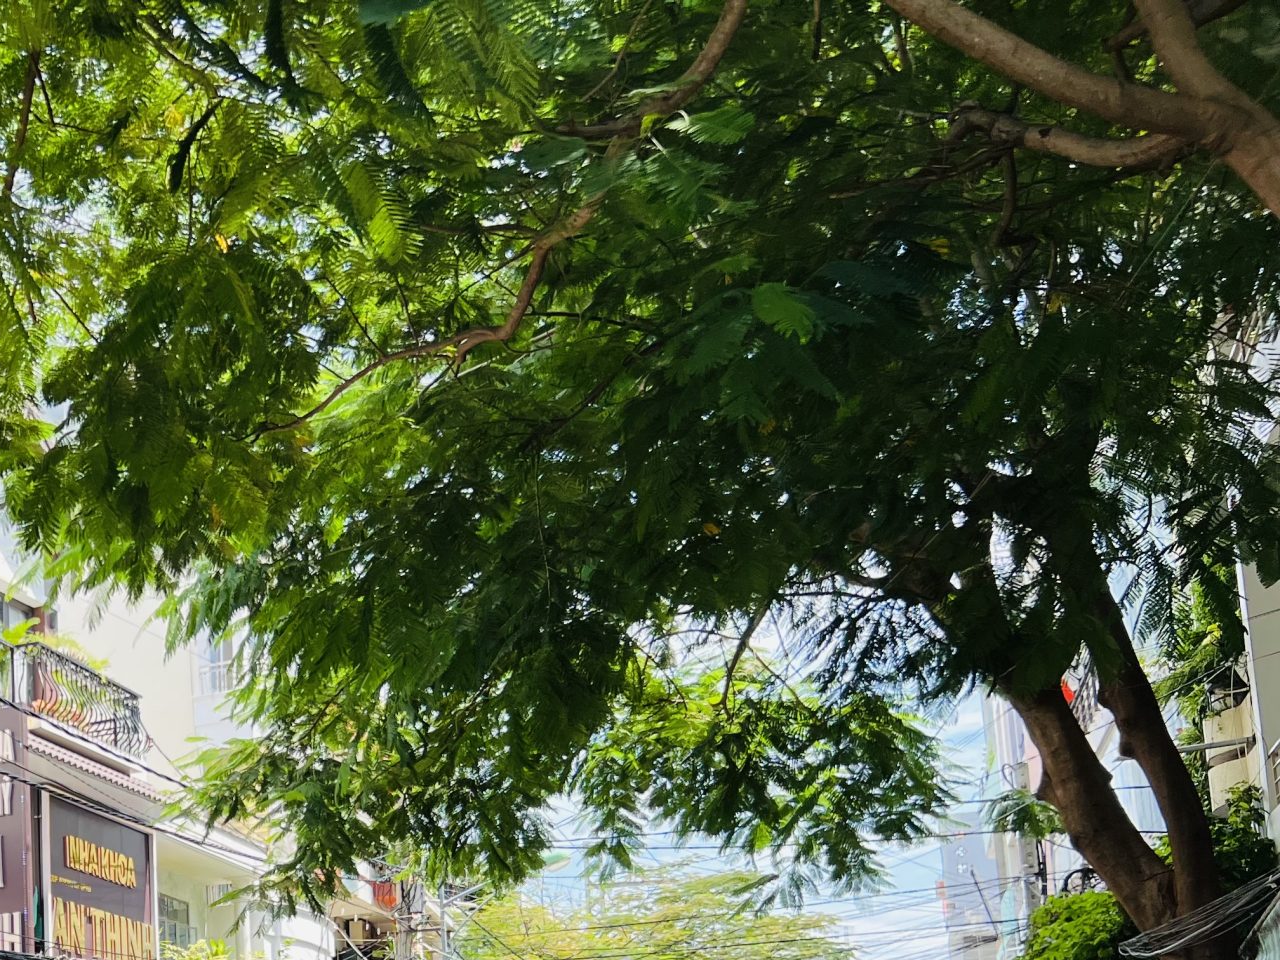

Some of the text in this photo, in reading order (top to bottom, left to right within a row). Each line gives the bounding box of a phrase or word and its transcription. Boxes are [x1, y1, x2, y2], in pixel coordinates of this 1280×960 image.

[63, 835, 137, 890] NHA KHOA
[53, 896, 86, 956] AN
